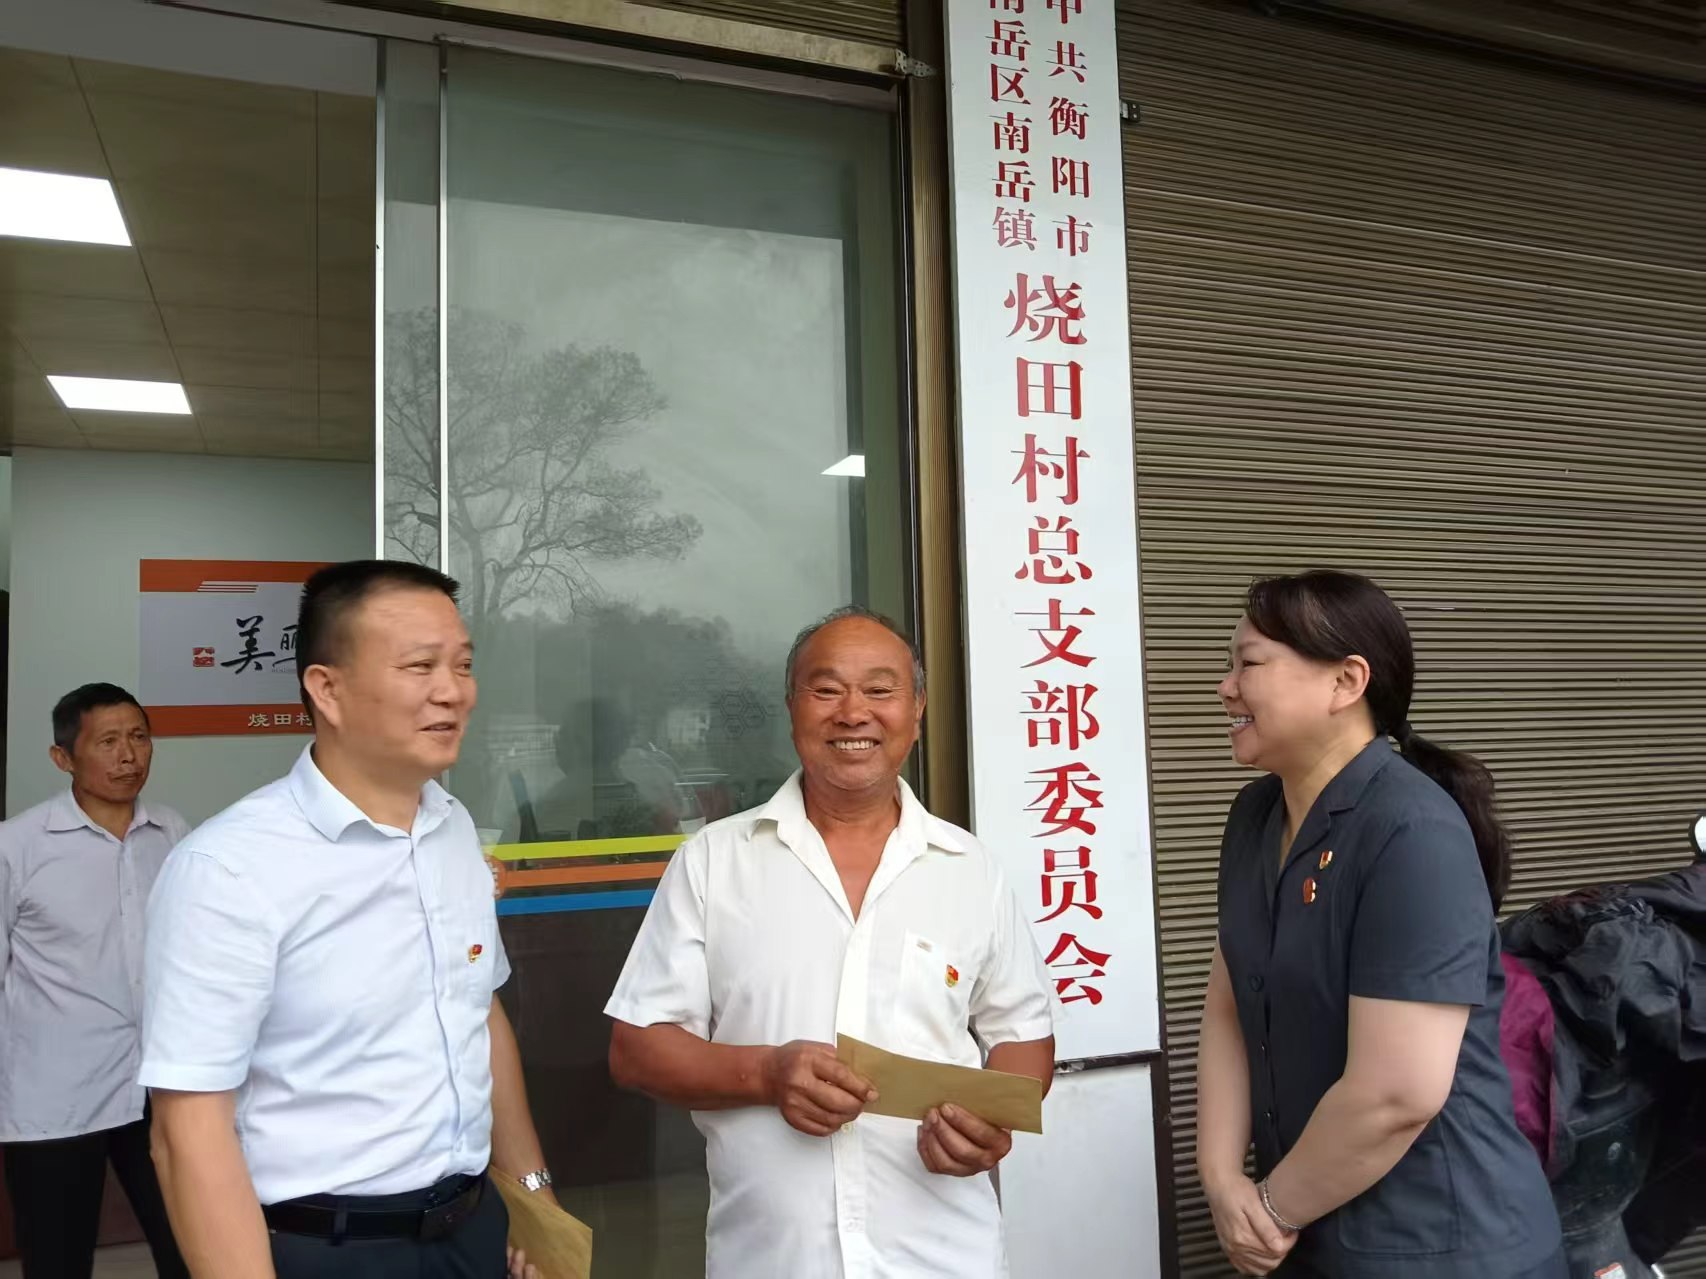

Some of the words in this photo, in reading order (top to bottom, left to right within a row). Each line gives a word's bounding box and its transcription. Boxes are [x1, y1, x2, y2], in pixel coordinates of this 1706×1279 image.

[1003, 272, 1113, 1006] 烧田村总支部委员会
